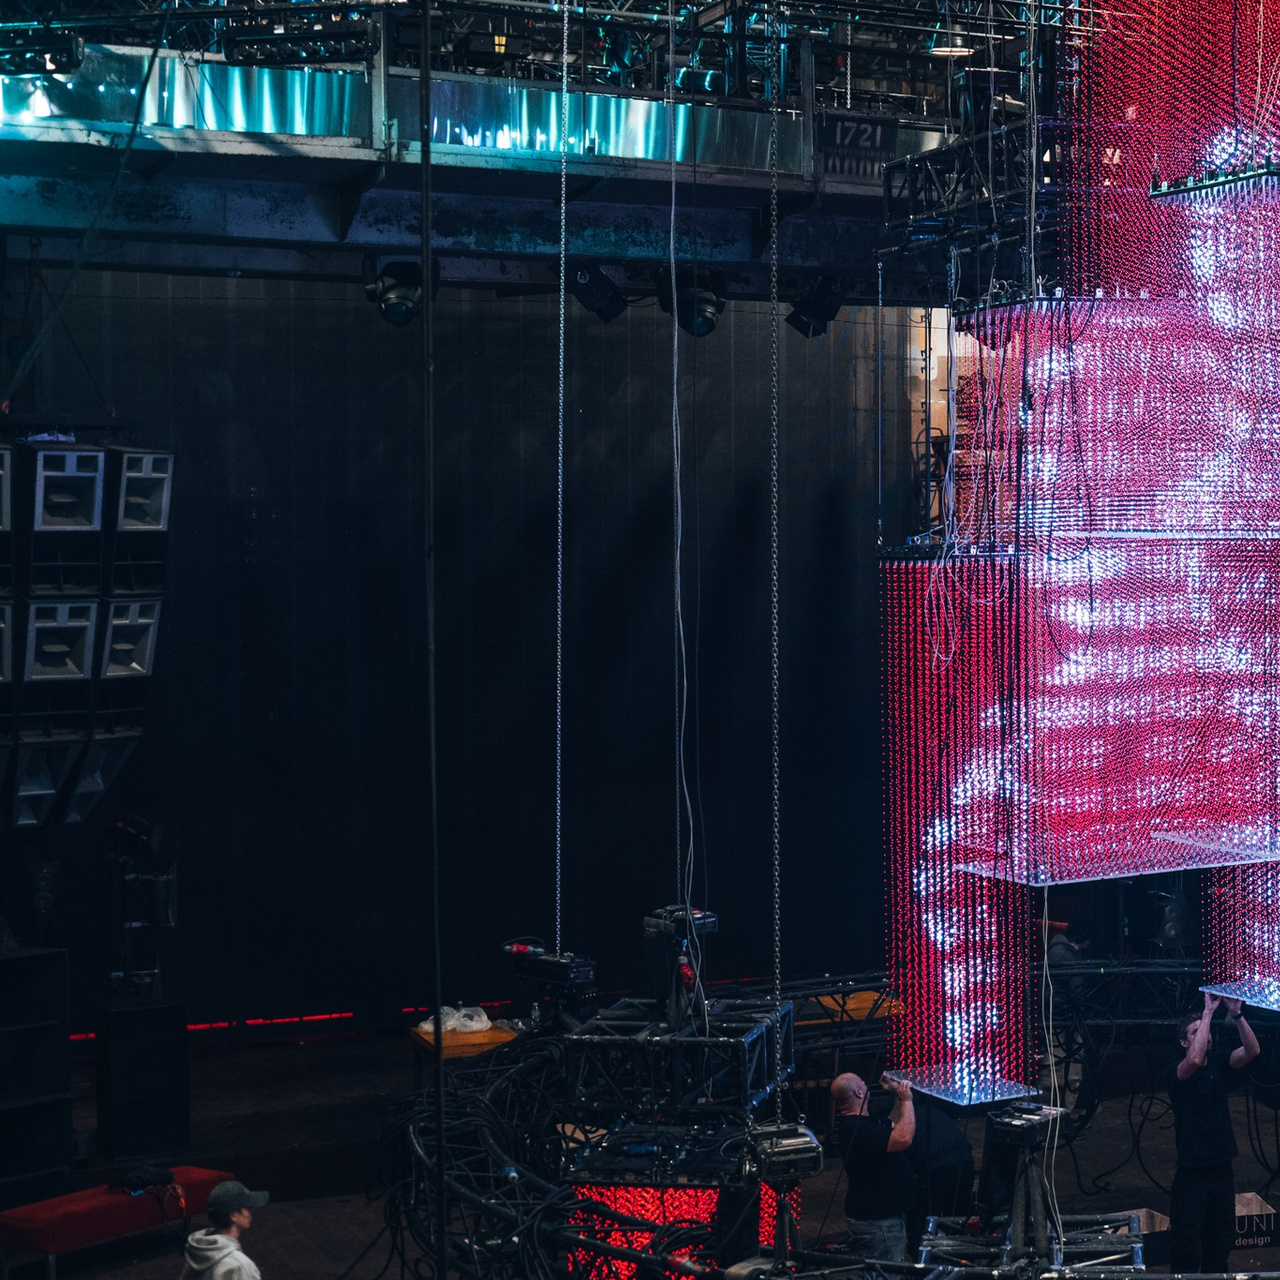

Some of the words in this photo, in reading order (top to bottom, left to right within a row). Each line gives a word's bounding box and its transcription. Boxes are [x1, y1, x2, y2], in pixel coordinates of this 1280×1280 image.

[835, 121, 882, 148] 1721
[1235, 1214, 1274, 1234] UNI
[1235, 1235, 1271, 1246] design
